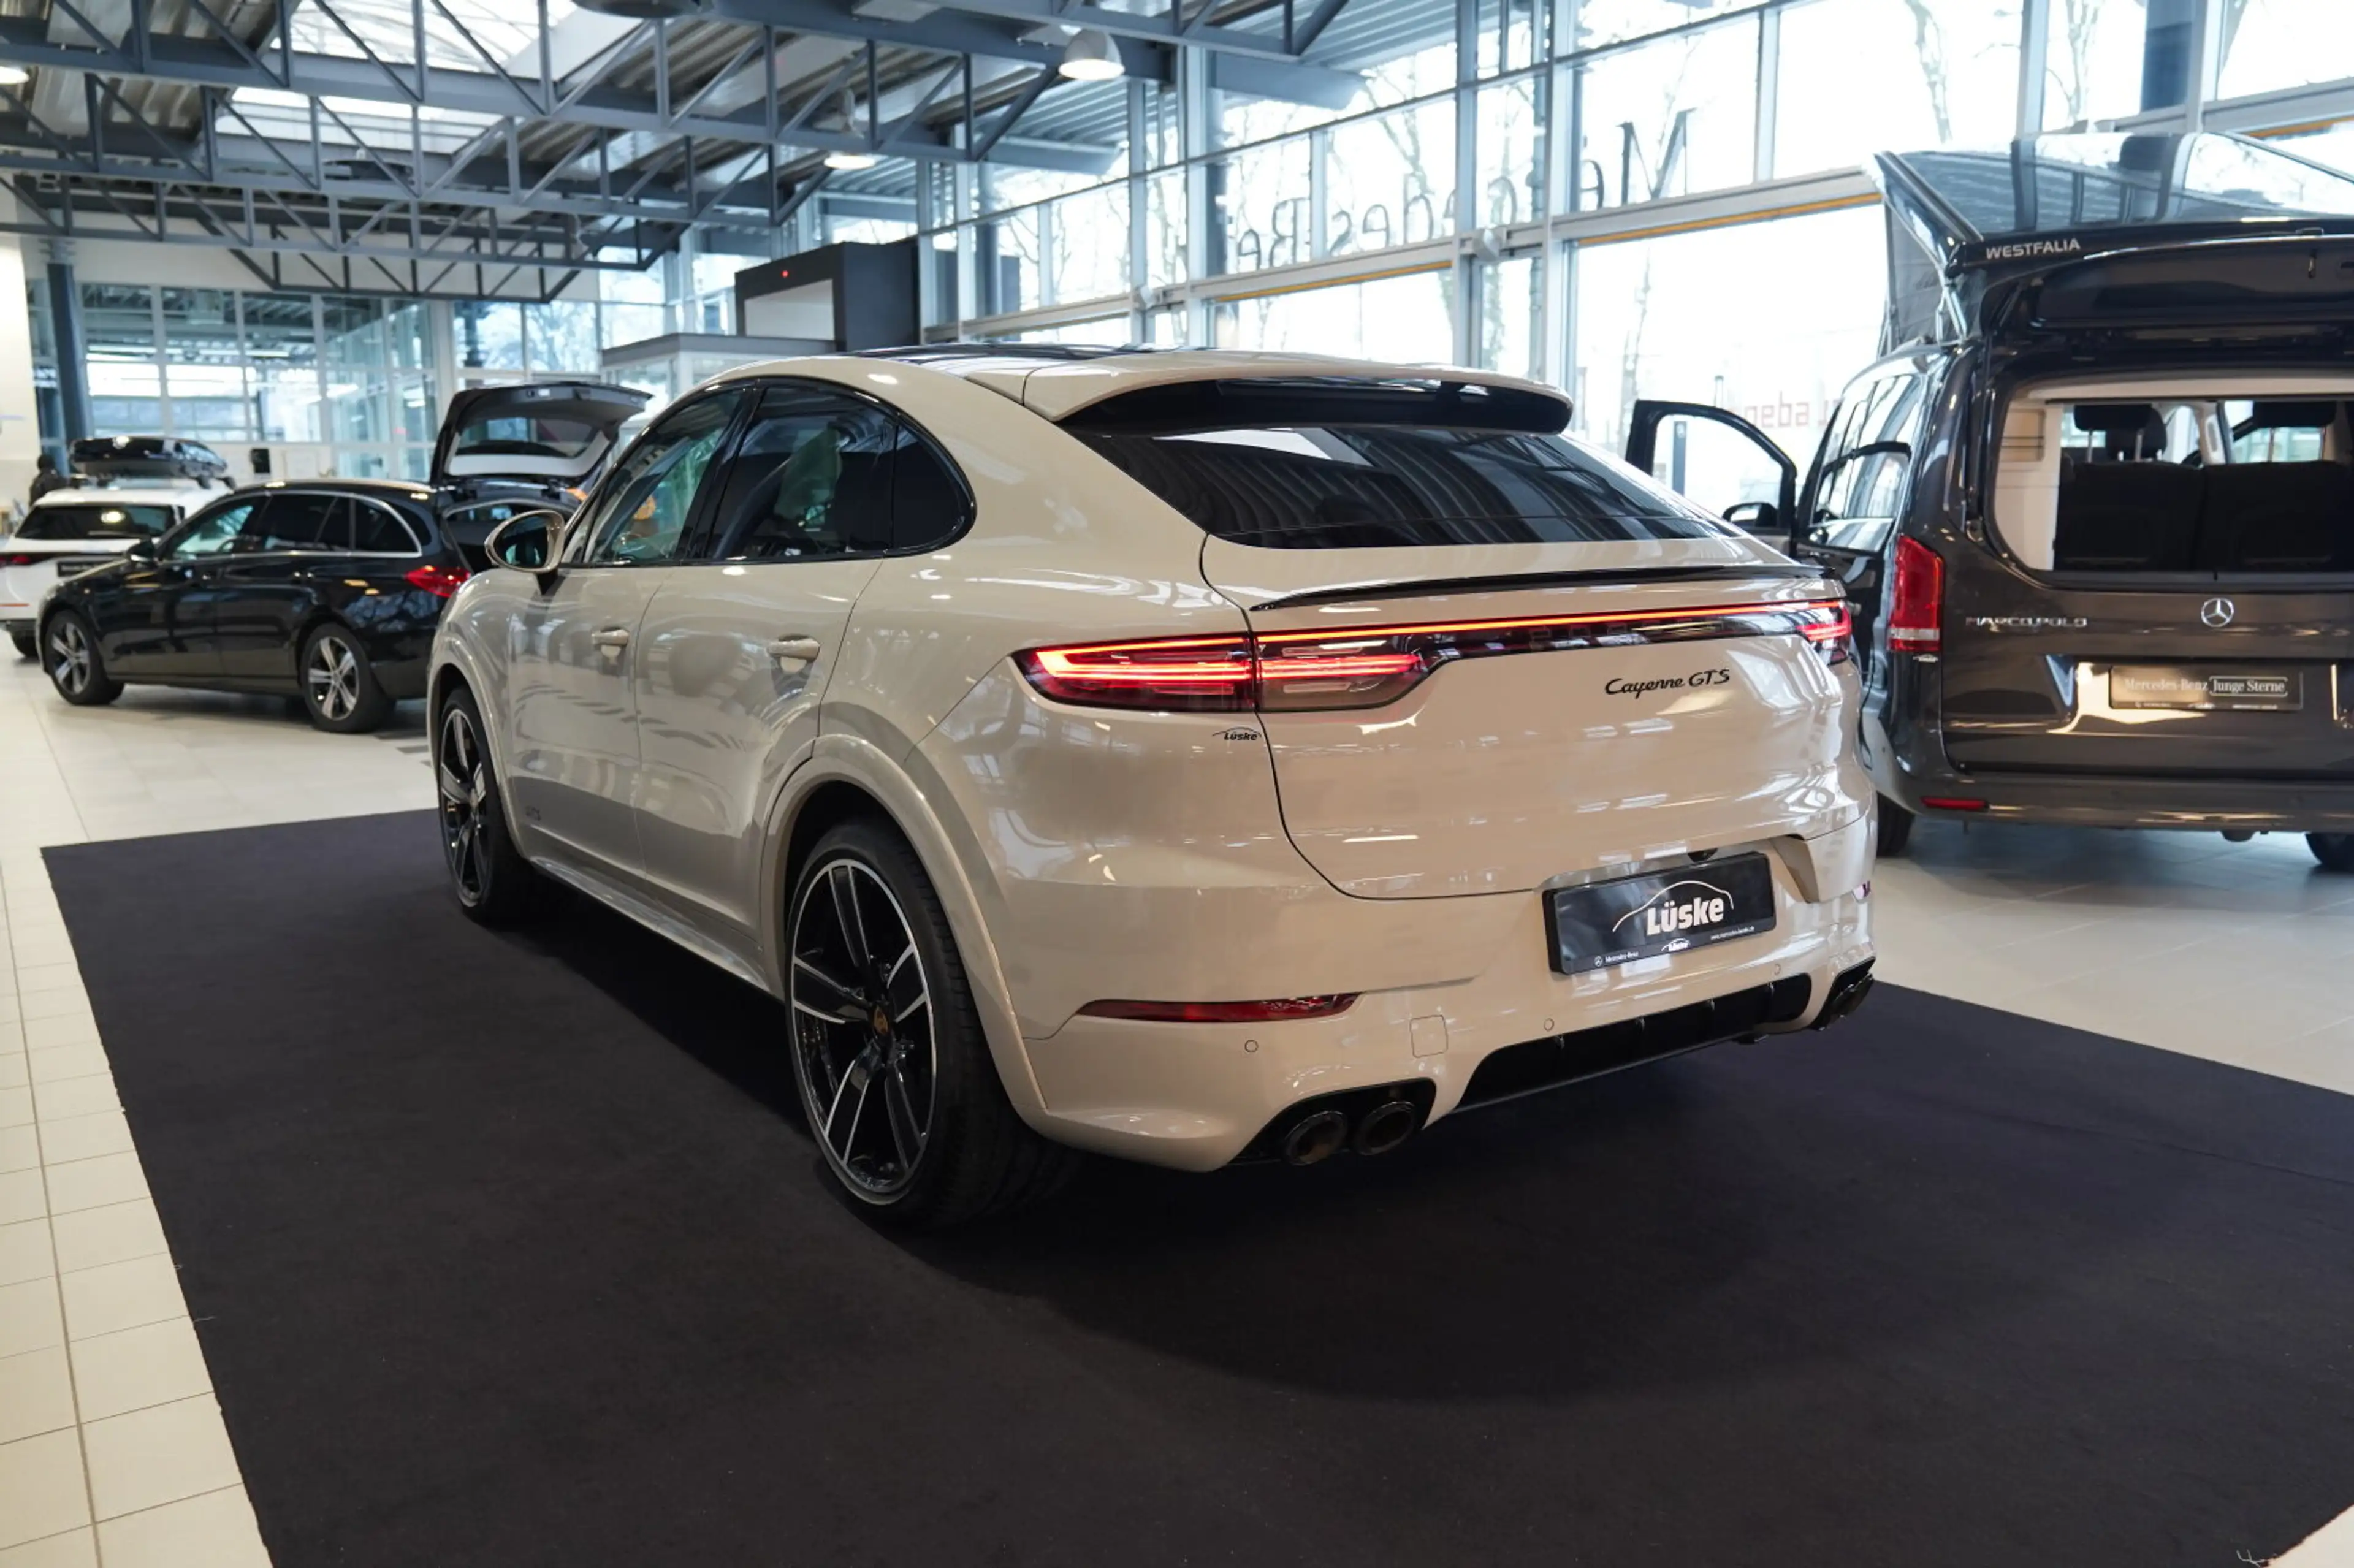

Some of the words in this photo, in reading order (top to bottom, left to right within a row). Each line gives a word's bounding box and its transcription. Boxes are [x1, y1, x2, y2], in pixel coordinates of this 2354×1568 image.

[1986, 237, 2081, 260] WESTFALIA
[1604, 677, 1685, 698] Cayenne
[1688, 667, 1731, 687] GTS
[2125, 677, 2208, 691] Mercedes-Benz
[2212, 679, 2245, 694] Junge
[2246, 679, 2285, 693] Sterne
[1646, 897, 1724, 937] Lüske
